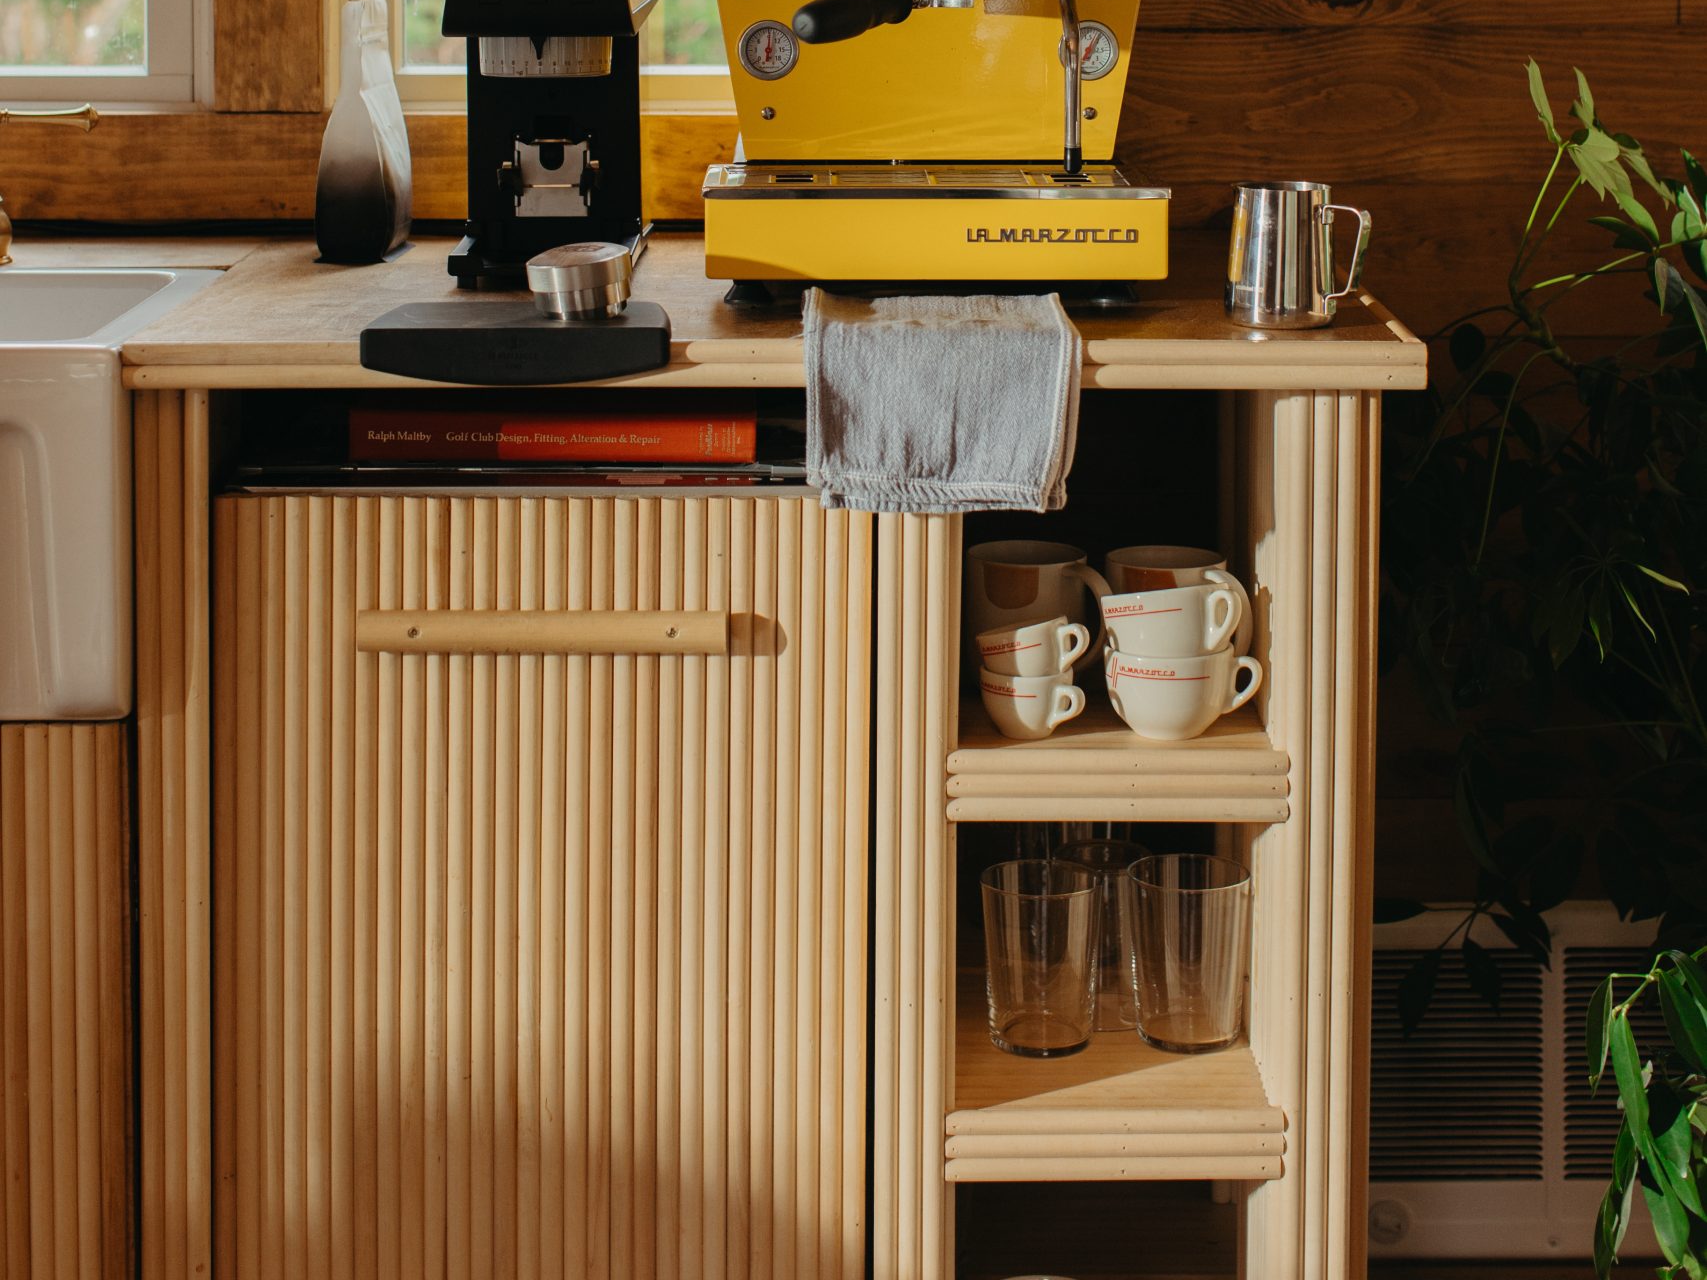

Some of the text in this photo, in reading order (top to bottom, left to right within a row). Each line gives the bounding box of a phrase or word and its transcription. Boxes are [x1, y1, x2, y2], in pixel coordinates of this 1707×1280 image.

[967, 228, 1139, 244] LA MARZOCCO
[367, 430, 432, 443] Ralph Maltby
[446, 432, 661, 446] Golf Club Design, Fitting, Alteration & Repair
